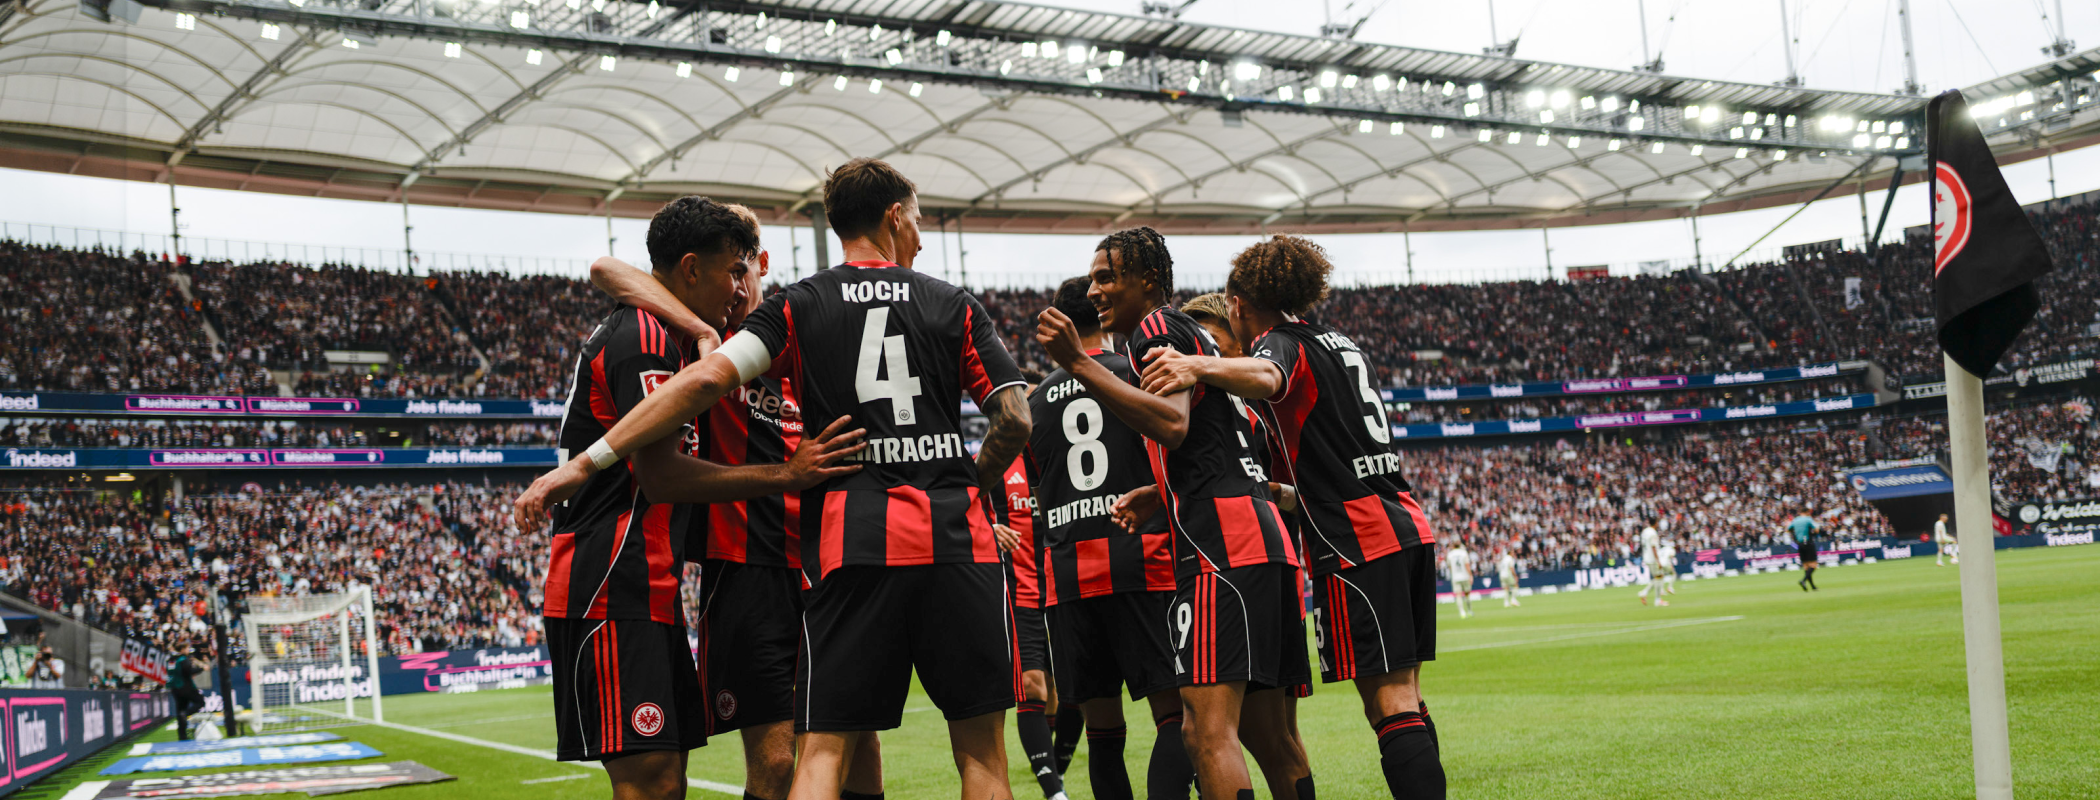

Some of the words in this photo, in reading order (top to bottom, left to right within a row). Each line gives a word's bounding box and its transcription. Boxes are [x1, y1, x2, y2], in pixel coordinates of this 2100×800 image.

[841, 281, 909, 303] KOCH
[855, 306, 922, 425] 4
[2028, 359, 2094, 377] COMMANDO
[2038, 370, 2087, 384] GIESSEN
[1046, 378, 1087, 403] CHA
[1341, 351, 1390, 444] 3
[259, 398, 311, 411] München
[405, 400, 437, 414] Jobs
[438, 400, 482, 414] finden
[774, 418, 803, 432] finde
[1062, 397, 1108, 491] 8
[6, 449, 76, 467] indeed
[284, 451, 335, 463] München
[427, 451, 457, 464] Jobs
[459, 450, 503, 464] finden
[1868, 472, 1944, 487] mainova
[2045, 531, 2094, 547] indeed
[1177, 602, 1192, 650] 9
